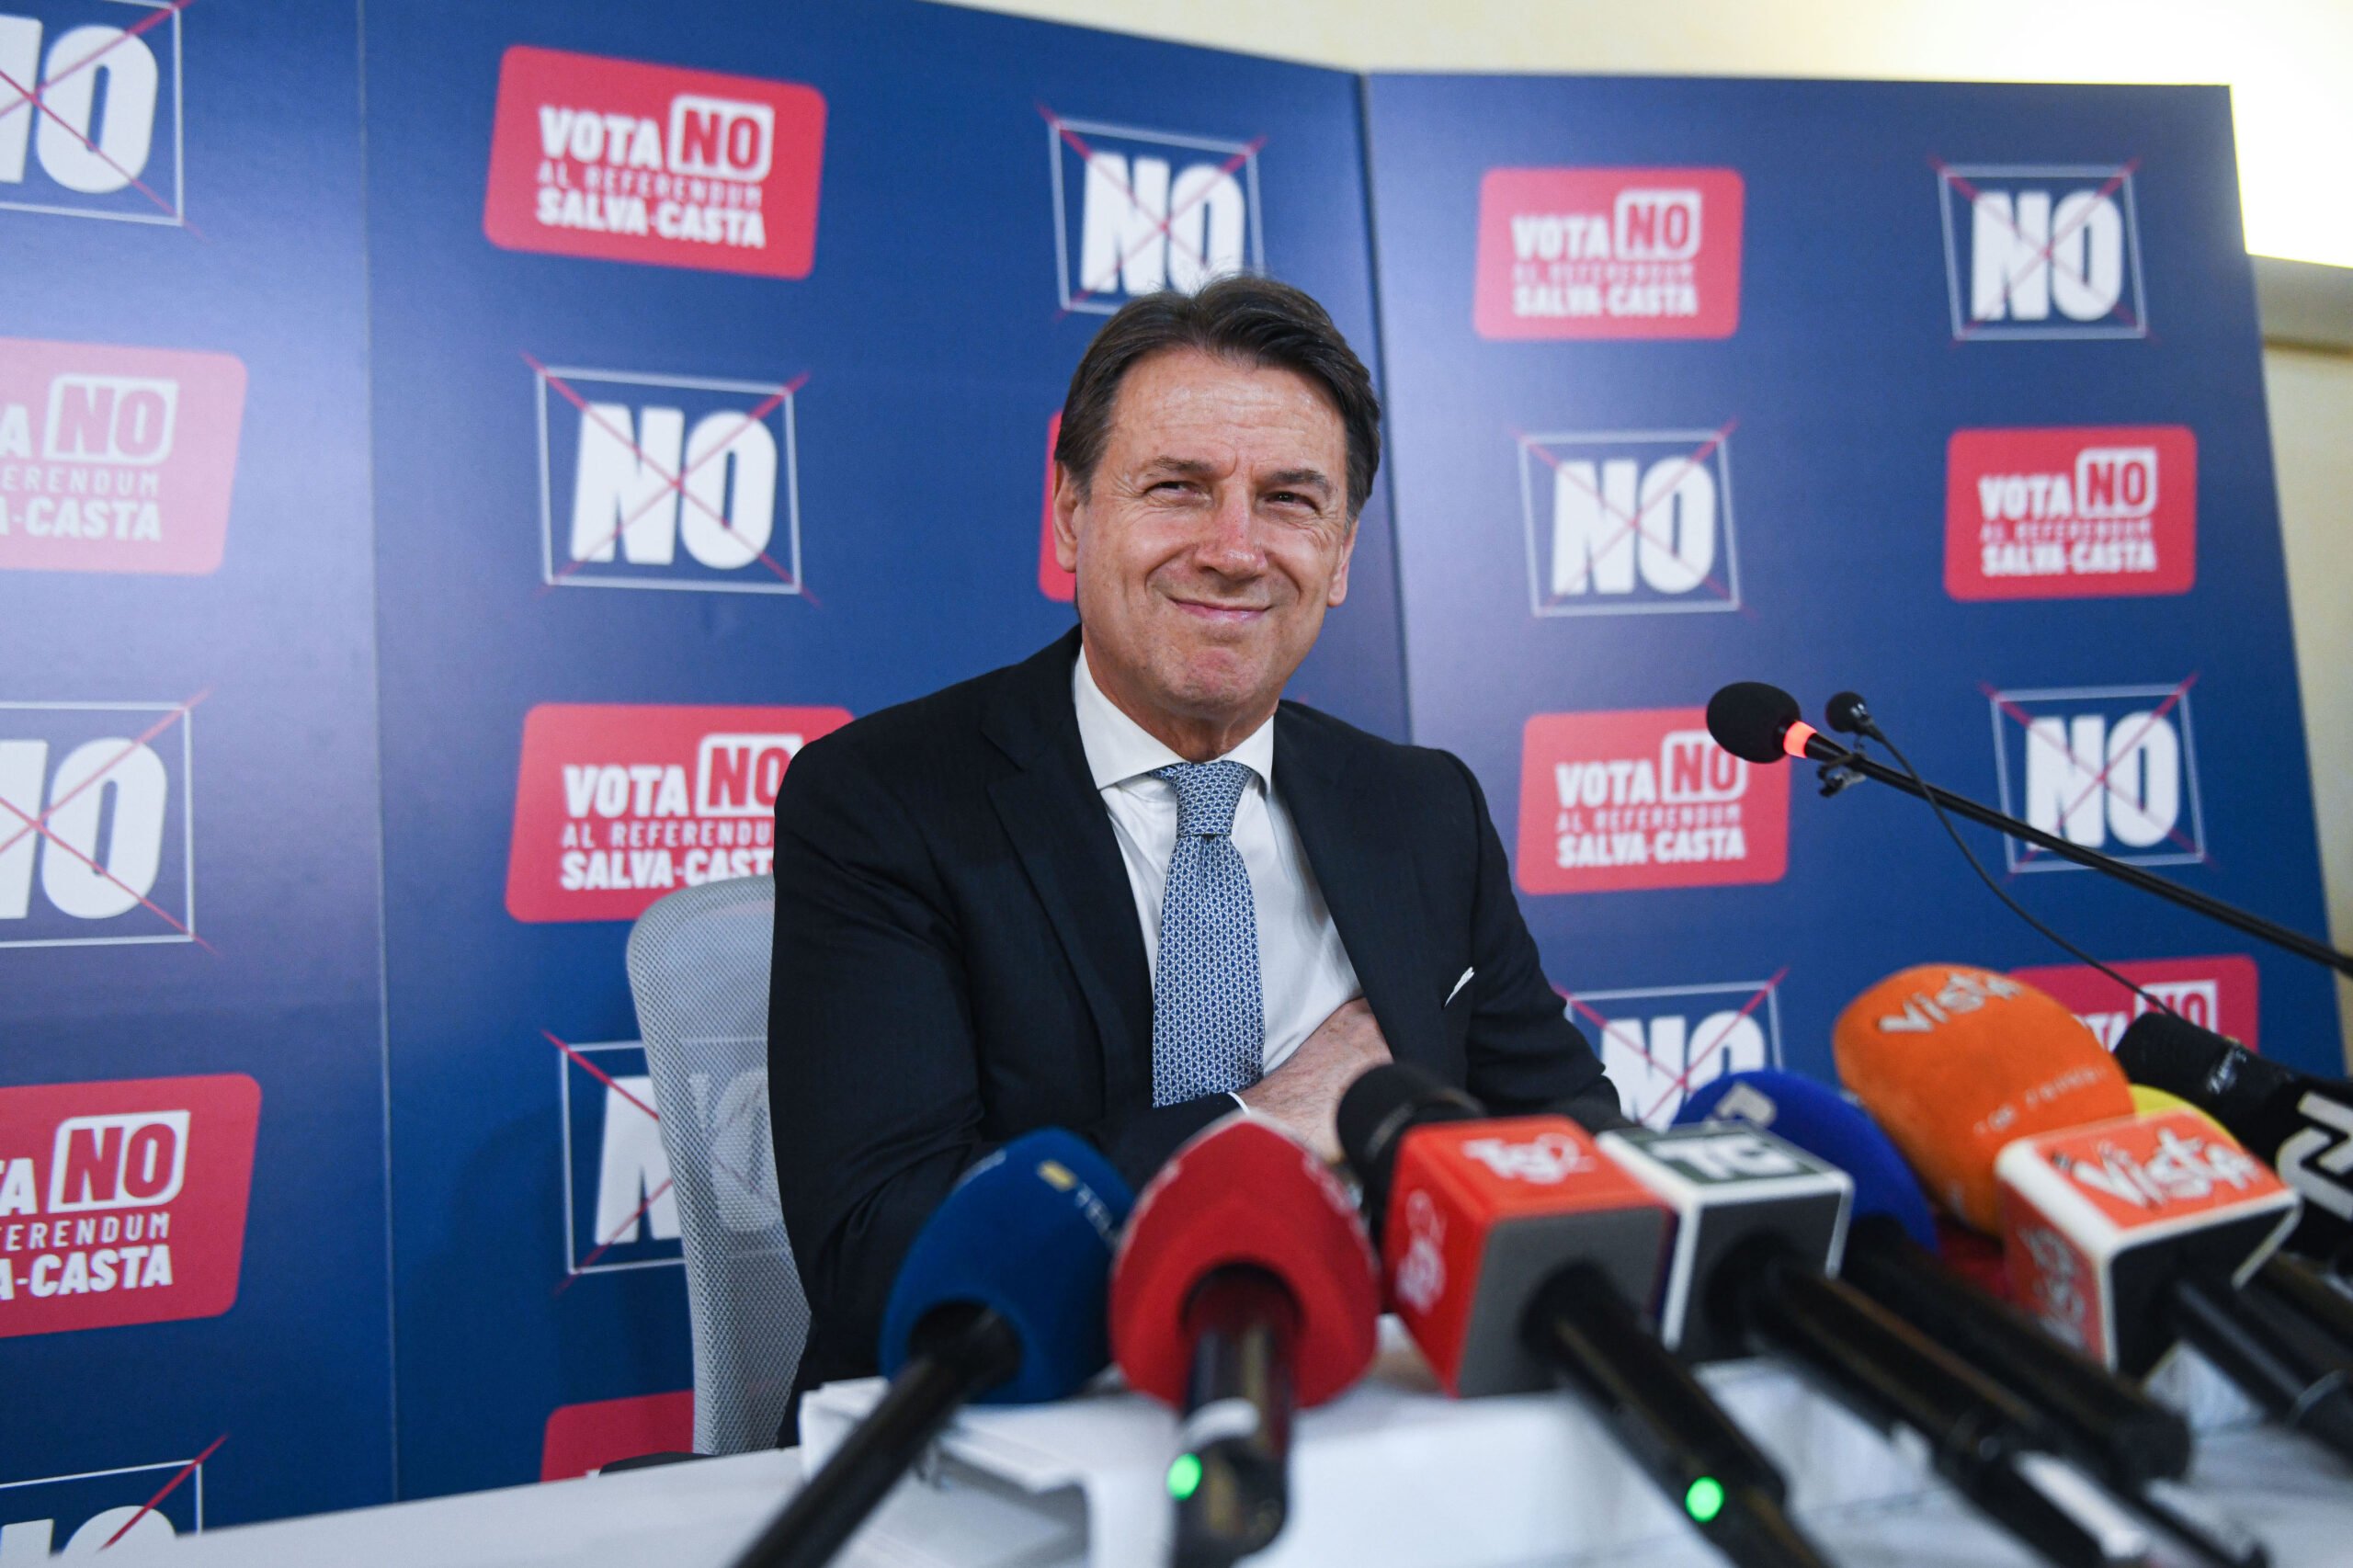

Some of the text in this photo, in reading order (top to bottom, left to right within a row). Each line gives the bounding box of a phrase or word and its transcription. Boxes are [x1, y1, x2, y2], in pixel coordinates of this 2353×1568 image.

[539, 103, 766, 173] VOTA NO
[536, 187, 767, 248] SALVA-CASTA
[1078, 153, 1246, 298] NO
[1511, 199, 1693, 261] VOTA NO
[1971, 190, 2123, 323] NO
[52, 381, 170, 460] NO
[1, 464, 160, 497] ERENDUM
[569, 402, 778, 570] NO
[1978, 458, 2150, 521] VOTA NO
[1552, 457, 1716, 595] NO
[563, 743, 794, 818] VOTA NO
[1555, 739, 1741, 809] VOTA NO
[2027, 711, 2181, 851] NO
[560, 847, 774, 891] SALVA-CAST
[562, 820, 774, 848] AL REFERENDU
[57, 1119, 180, 1208] NO
[0, 1212, 170, 1252] ERENDUM
